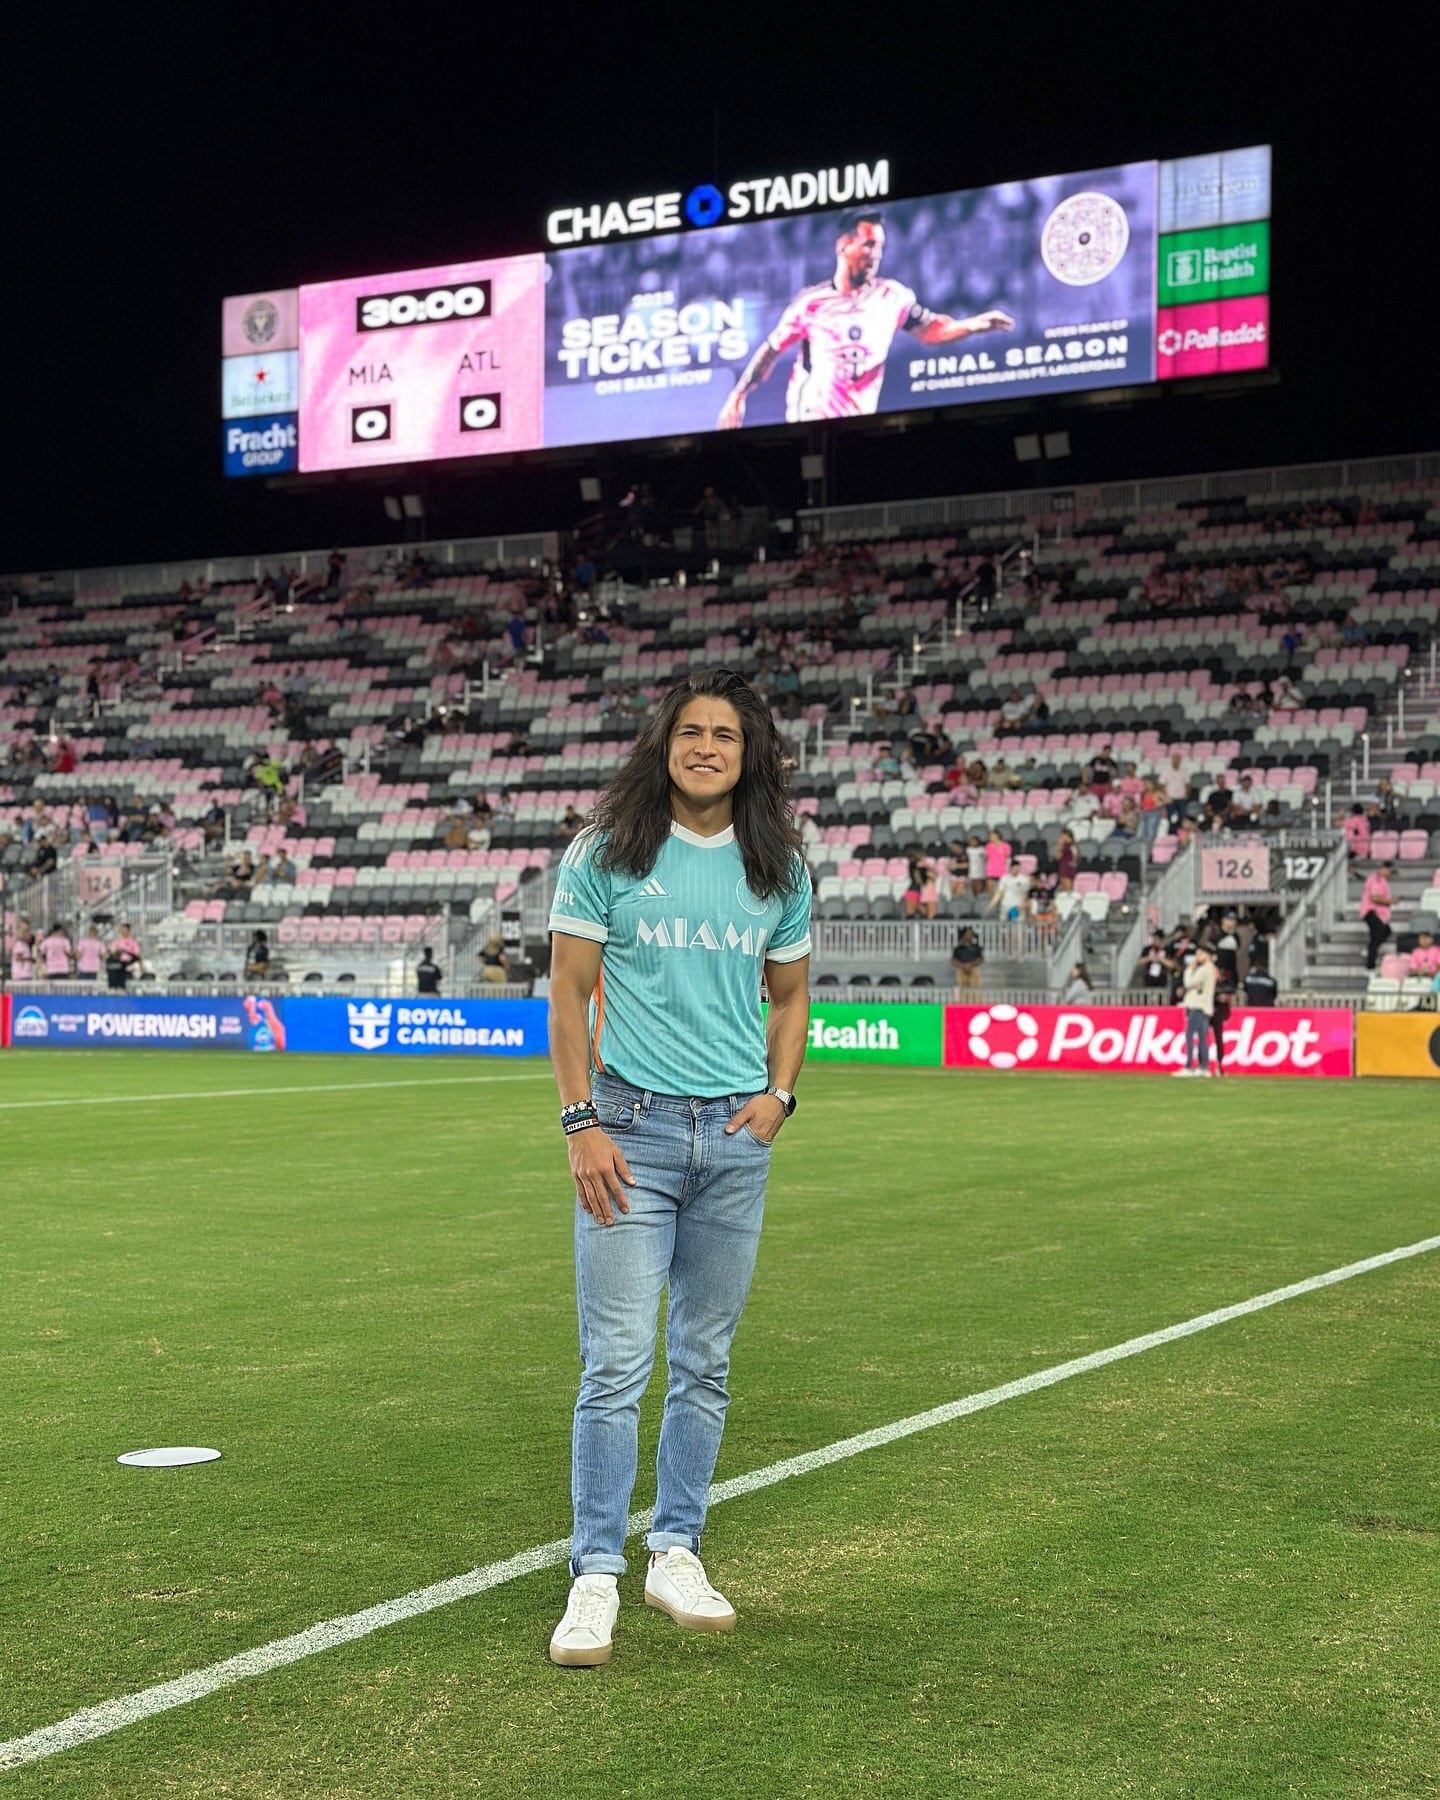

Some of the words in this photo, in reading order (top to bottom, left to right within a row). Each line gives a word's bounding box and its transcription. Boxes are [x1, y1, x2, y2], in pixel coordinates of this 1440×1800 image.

[547, 192, 682, 244] CHASE
[728, 159, 889, 219] STADIUM
[1204, 260, 1255, 282] Health
[361, 285, 486, 328] 30:00
[562, 297, 745, 349] SEASON
[1183, 321, 1265, 351] Polkadot
[349, 363, 393, 385] MIA
[458, 350, 502, 374] ATL
[557, 328, 750, 379] TICKETS
[909, 351, 996, 378] FINAL
[1005, 335, 1128, 367] SEASON
[355, 409, 388, 439] 0
[463, 398, 497, 429] 0
[227, 422, 296, 454] Fracht
[242, 449, 284, 467] GROUP
[86, 875, 111, 892] 124
[1216, 859, 1253, 879] 126
[1283, 856, 1325, 880] 127
[636, 916, 768, 957] MIAMI
[87, 1013, 216, 1038] POWERWASH
[397, 1008, 467, 1027] ROYAL
[396, 1027, 524, 1047] CARIBBEAN
[807, 1018, 899, 1050] Health
